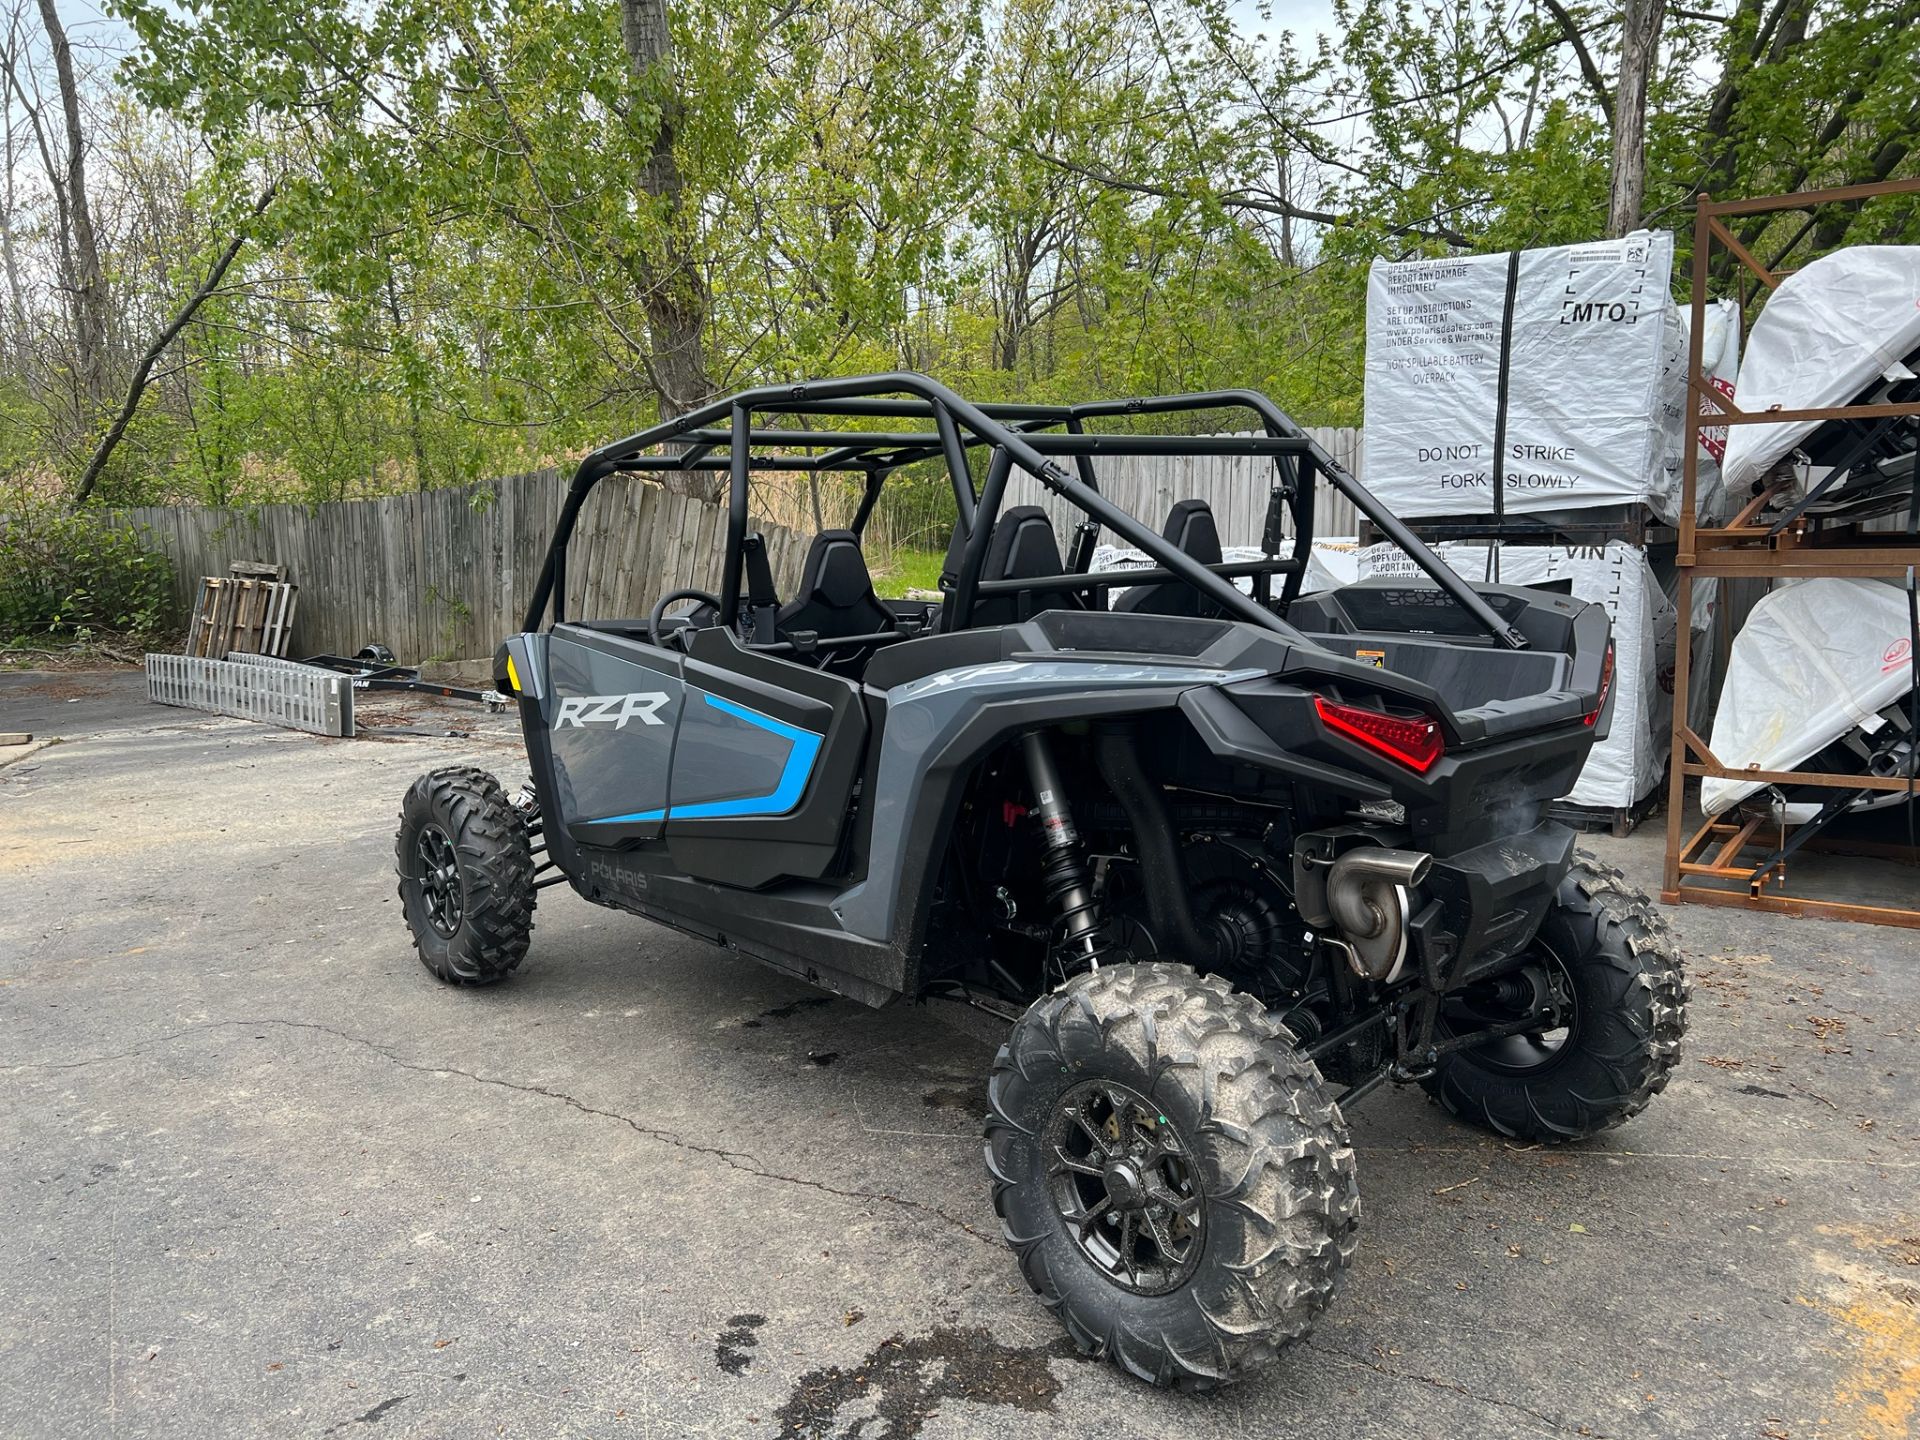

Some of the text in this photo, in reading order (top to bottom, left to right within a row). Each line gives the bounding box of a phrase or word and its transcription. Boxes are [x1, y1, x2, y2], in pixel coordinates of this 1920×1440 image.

[1387, 264, 1407, 275] OPEN
[1409, 262, 1430, 271] UPON
[1387, 267, 1467, 285] REPORT ANY DAMAGE
[1387, 282, 1437, 296] IMMEDIATELY
[1387, 300, 1472, 316] SET UP INSTRUCTIONS
[1572, 302, 1626, 322] MTO
[1386, 313, 1449, 326] ARE LOCATED AT
[1386, 321, 1493, 337] www.polarisdealers.com
[1386, 331, 1495, 347] UNDER Service & Warranty
[1450, 353, 1484, 366] BATTERY
[1413, 372, 1456, 385] OVERPACK
[1418, 444, 1575, 462] DO NOT STRIKE
[1441, 472, 1580, 488] FORK SLOWLY
[1566, 545, 1606, 560] VIN
[1402, 562, 1416, 571] ANY
[553, 691, 671, 731] RZR
[591, 861, 647, 890] POLARIS
